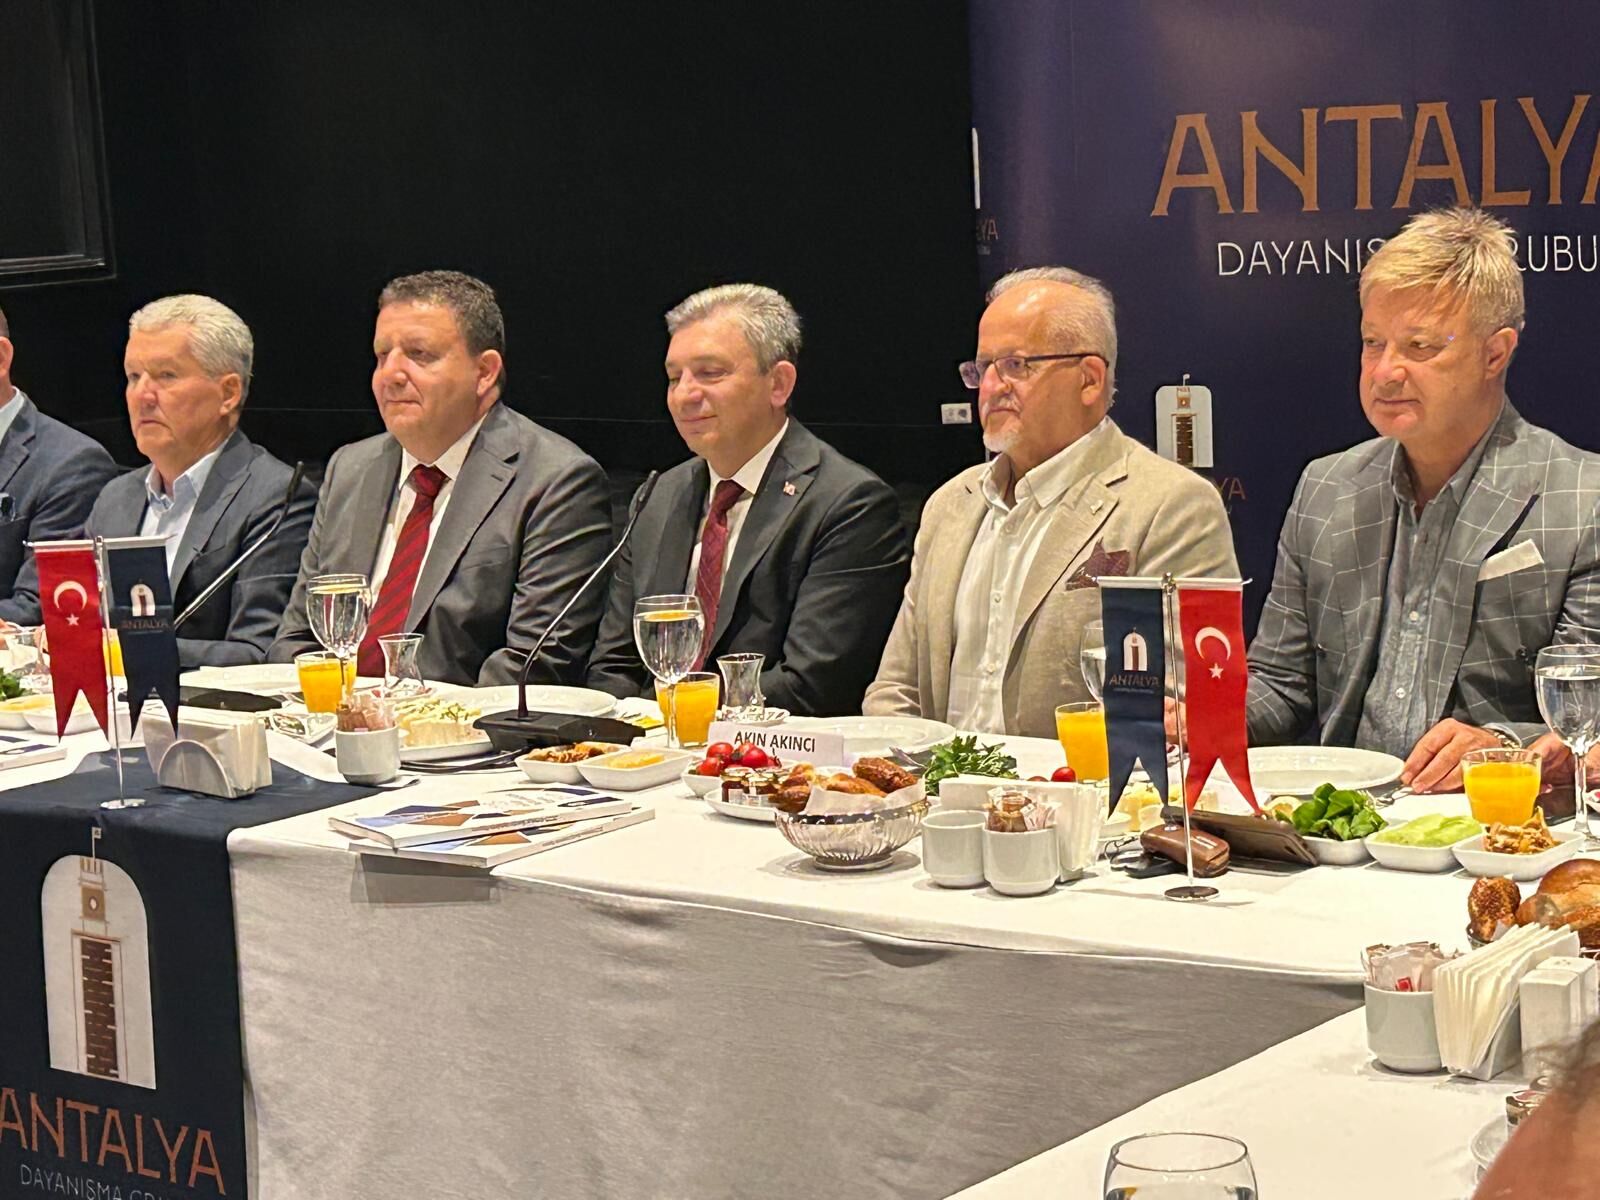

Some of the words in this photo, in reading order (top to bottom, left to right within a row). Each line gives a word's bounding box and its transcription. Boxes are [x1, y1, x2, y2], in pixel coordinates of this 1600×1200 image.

[1150, 94, 1600, 216] ANTALY
[1217, 238, 1387, 276] DAYANI
[734, 730, 767, 748] AKIN
[769, 734, 816, 753] AKINCI
[0, 1087, 226, 1196] ANTALYA
